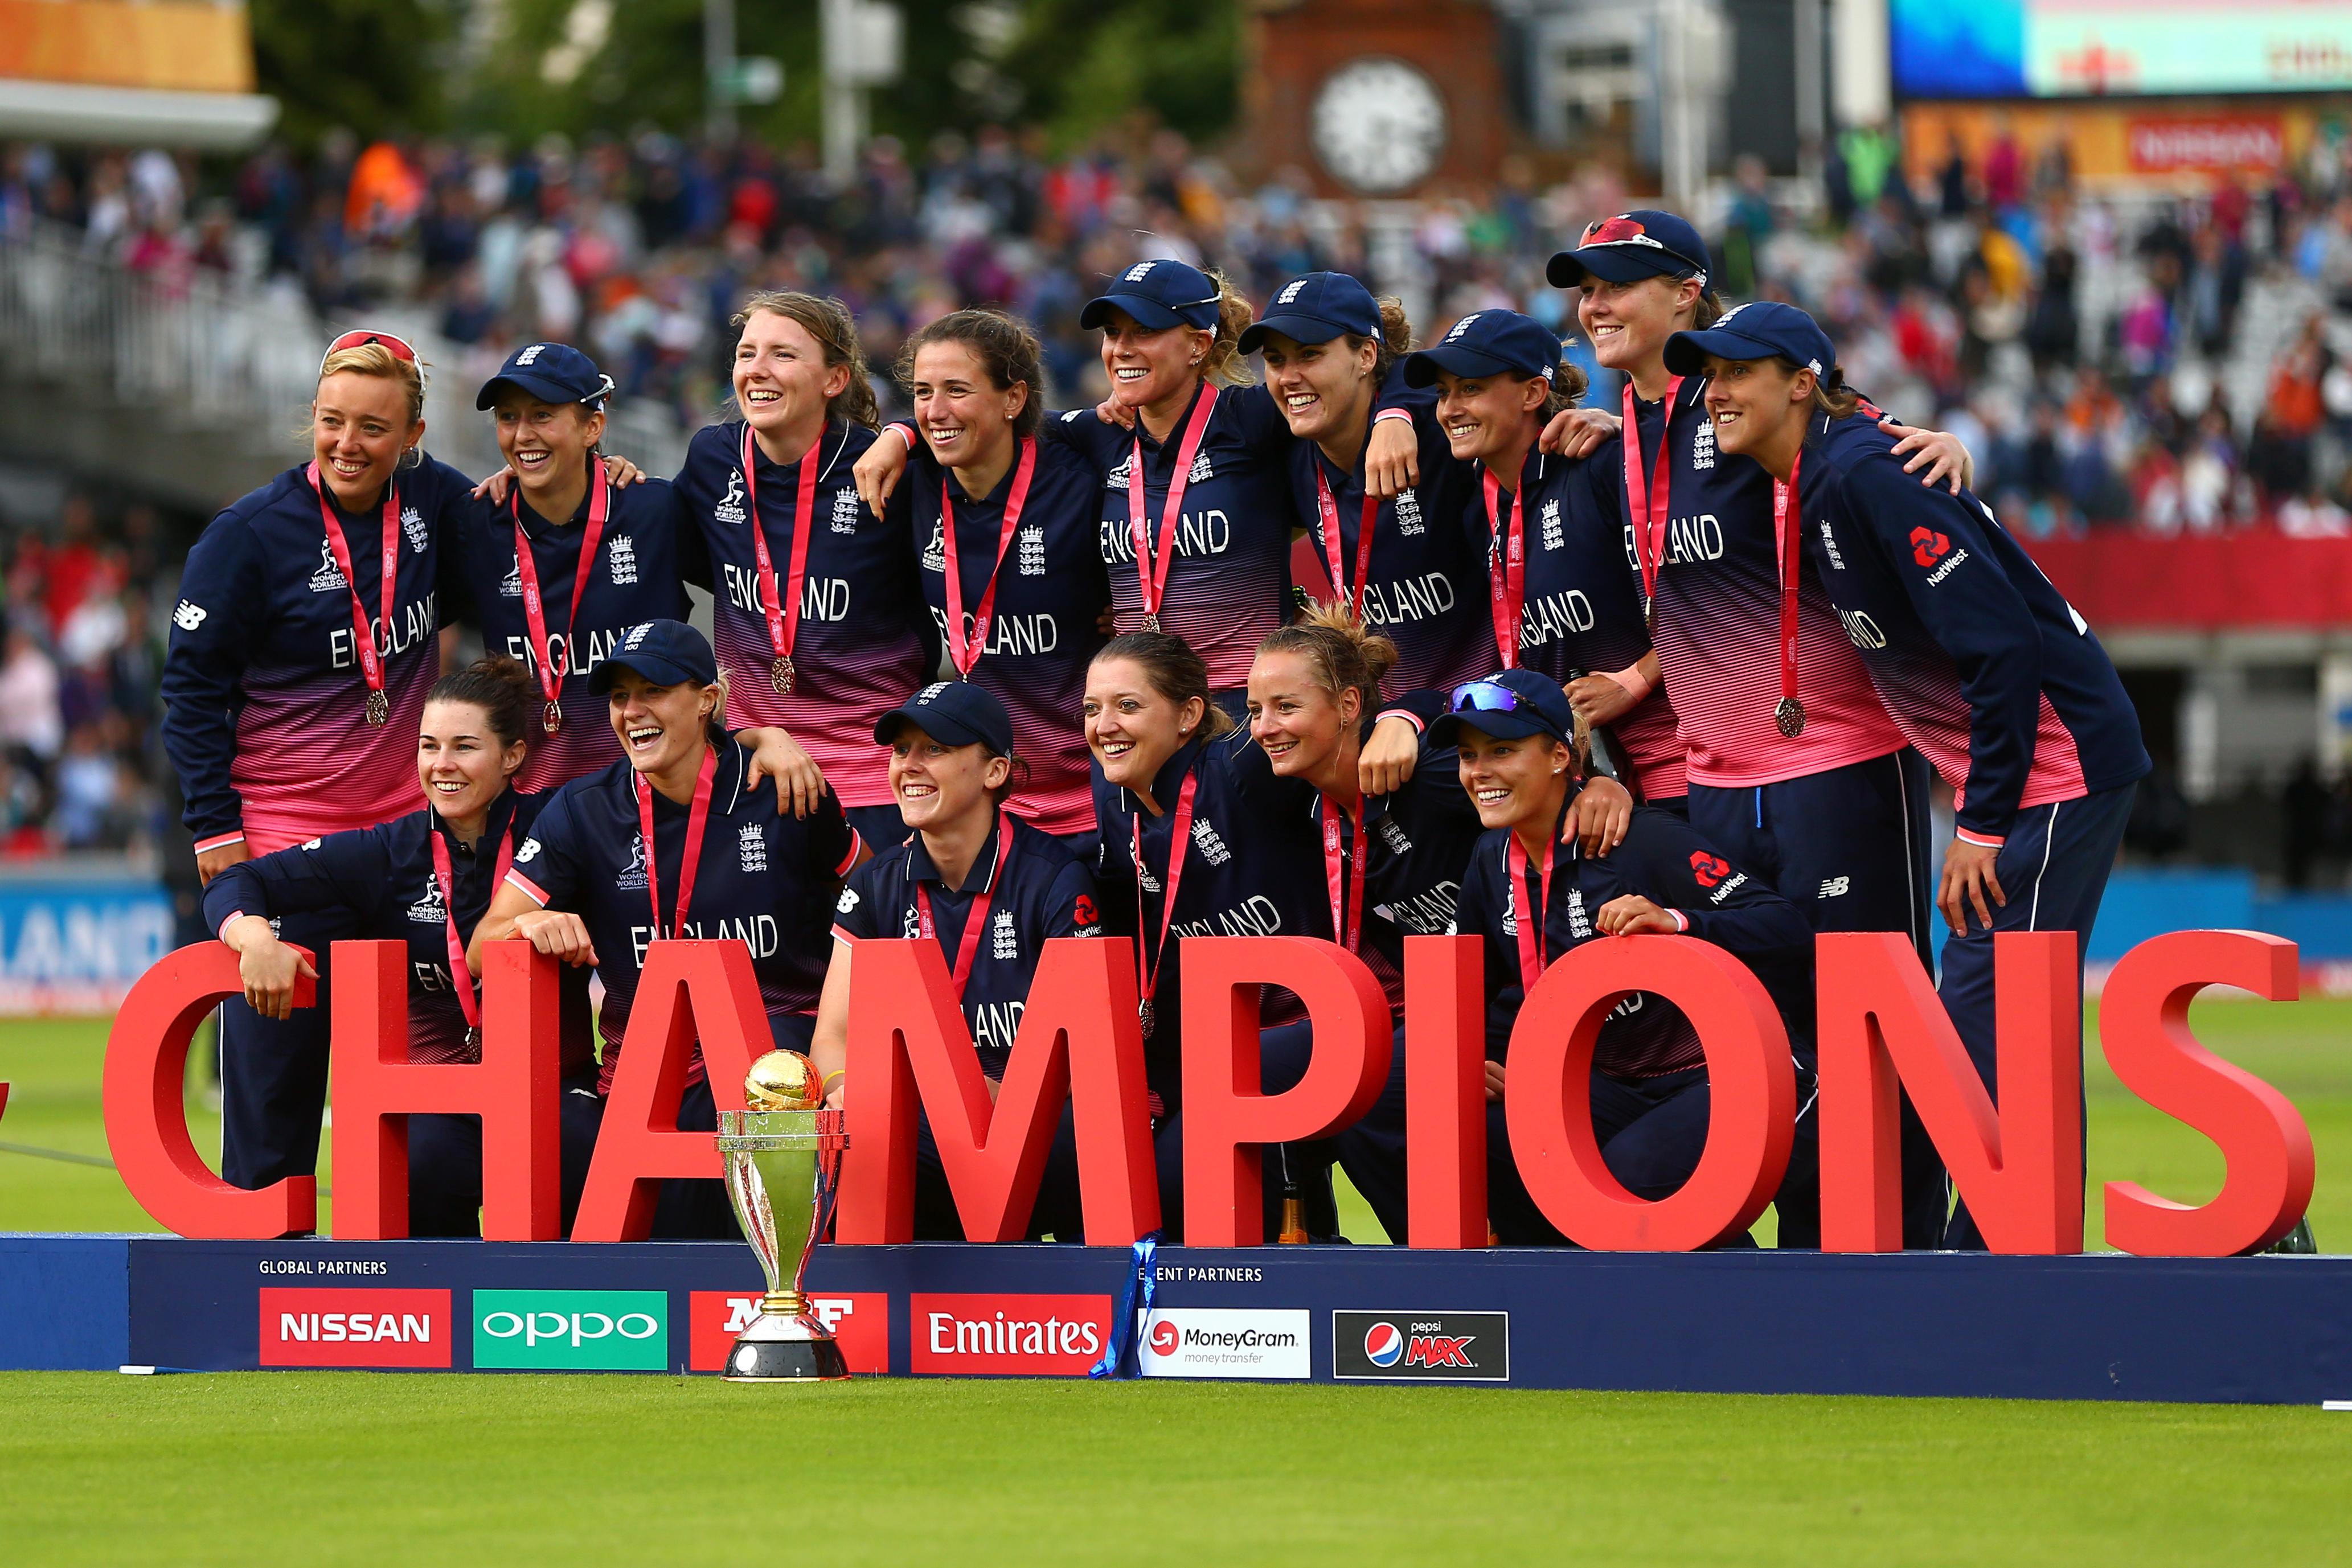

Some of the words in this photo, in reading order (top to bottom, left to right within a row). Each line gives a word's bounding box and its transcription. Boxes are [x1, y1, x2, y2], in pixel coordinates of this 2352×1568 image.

[714, 510, 734, 519] WORLD
[312, 573, 345, 582] WOMEN'S
[1926, 548, 1969, 587] NatWest
[309, 581, 336, 590] WORLD
[1334, 572, 1454, 625] GLAND
[507, 626, 634, 678] ENGLAN
[1709, 872, 1748, 905] NatWest
[407, 910, 433, 920] WORLD
[411, 905, 445, 915] WOMEN'S
[103, 929, 2313, 1257] CHAMPIONS
[259, 1260, 313, 1275] GLOBAL
[317, 1261, 387, 1275] PARTNERS
[1138, 1267, 1185, 1282] EENT
[1188, 1268, 1263, 1282] PARTNERS
[723, 1298, 854, 1332] MF
[280, 1312, 431, 1342] NISSAN
[928, 1310, 1099, 1355] Emirates
[1411, 1320, 1442, 1333] pepsi
[1184, 1328, 1296, 1350] MoneyGram
[1185, 1354, 1220, 1365] money
[1222, 1352, 1264, 1364] transfer
[1404, 1336, 1477, 1369] MAX
